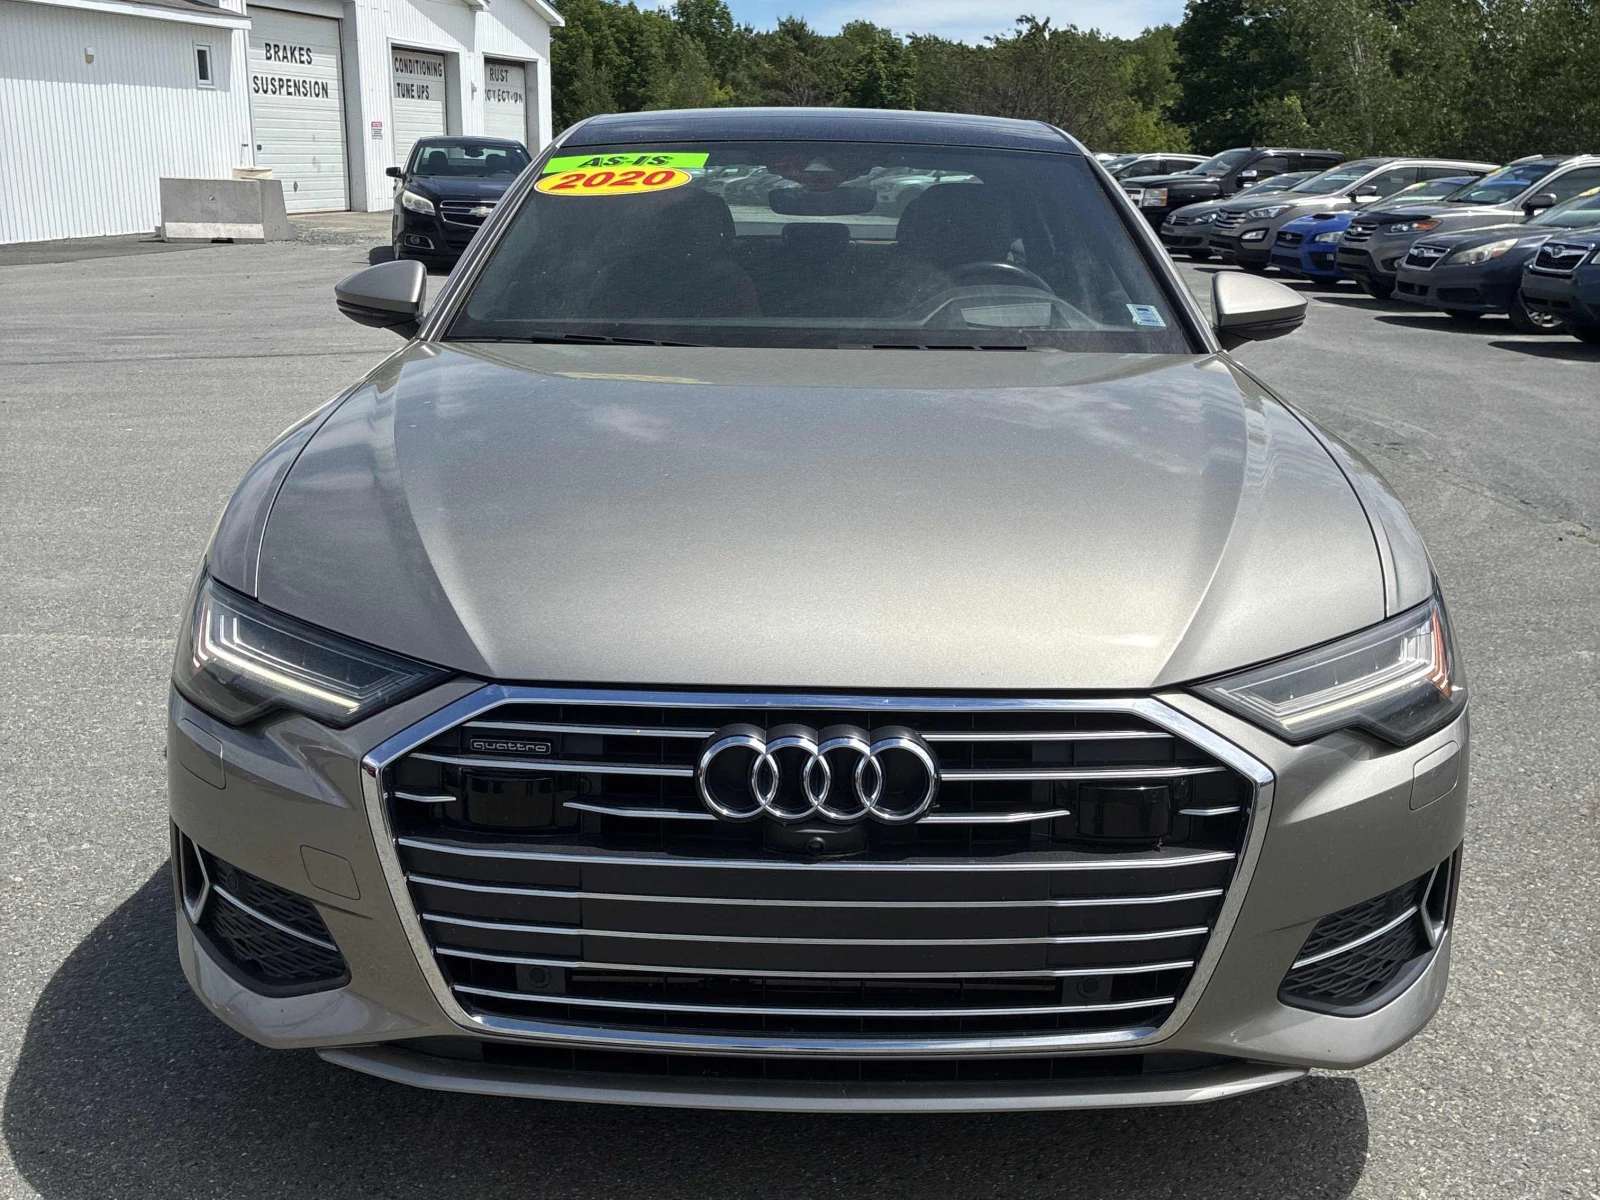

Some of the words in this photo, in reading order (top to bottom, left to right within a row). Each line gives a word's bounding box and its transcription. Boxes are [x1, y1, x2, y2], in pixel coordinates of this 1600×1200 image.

[264, 42, 313, 65] BRAKES
[394, 56, 443, 78] CONDITIONING
[489, 67, 509, 83] RUST
[252, 75, 329, 99] SUSPENSION
[396, 82, 415, 99] TUNE
[416, 83, 430, 100] UPS
[577, 155, 673, 168] AS-IS
[549, 170, 676, 191] 2020
[473, 741, 547, 752] quattro
